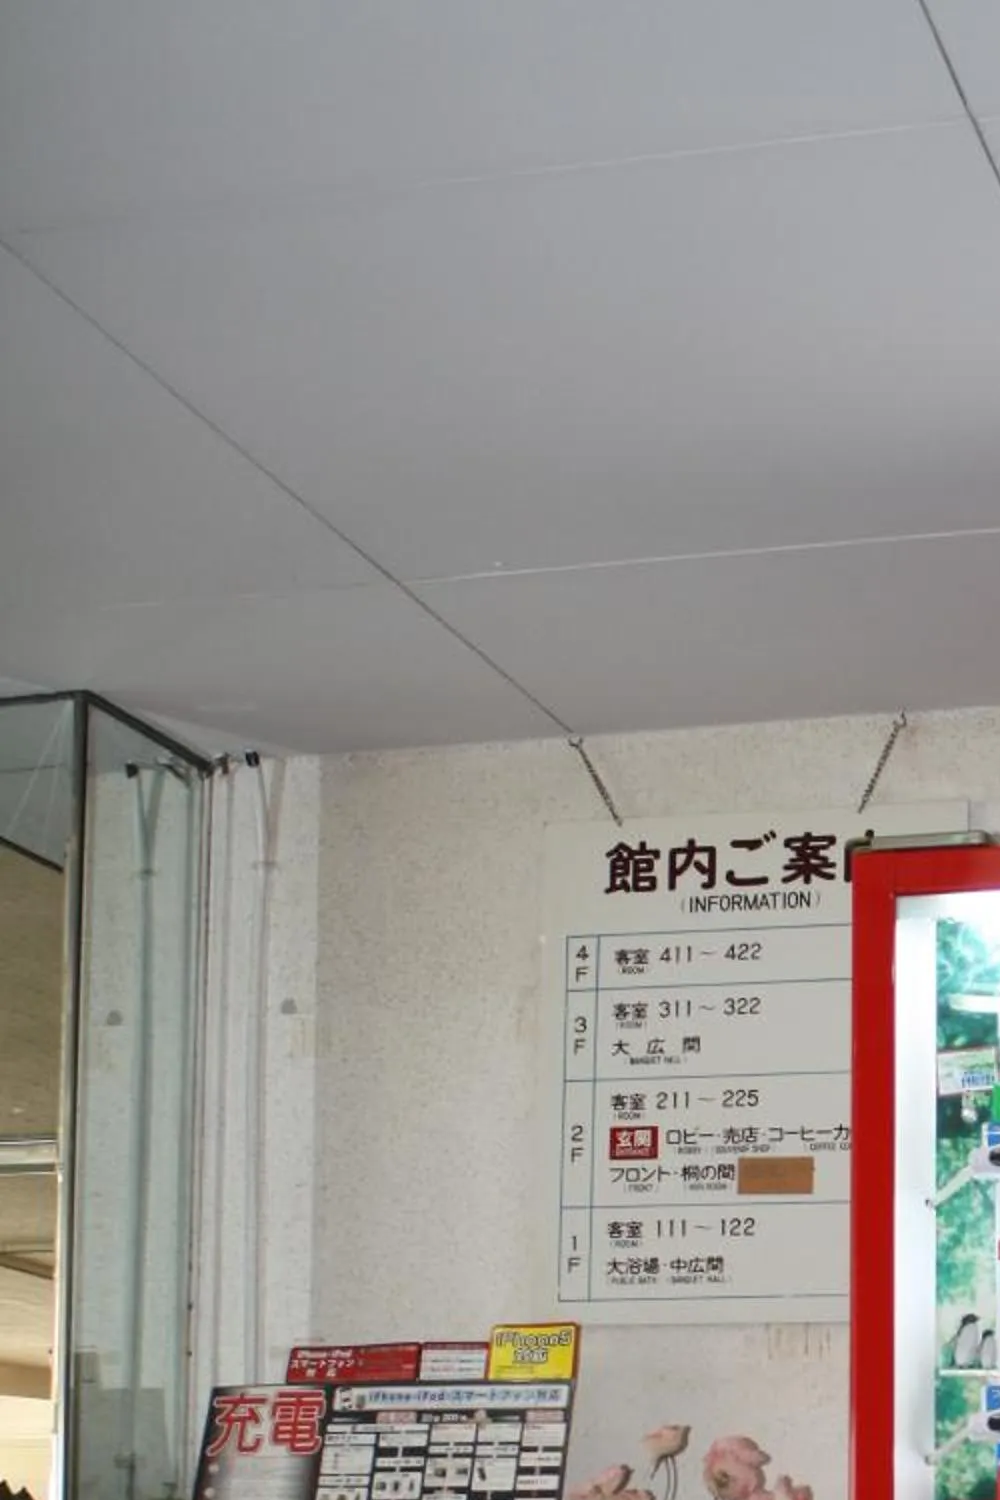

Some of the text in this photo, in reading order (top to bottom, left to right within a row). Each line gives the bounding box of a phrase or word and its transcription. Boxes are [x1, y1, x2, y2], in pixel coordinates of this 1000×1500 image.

[604, 830, 853, 894] 館内ご案
[614, 949, 650, 966] 客室
[659, 945, 693, 964] 411
[723, 943, 764, 962] 422
[613, 1002, 649, 1020] 客室
[658, 1000, 692, 1019] 311
[722, 997, 762, 1016] 322
[610, 1094, 647, 1111] 客室
[655, 1091, 690, 1110] 211
[721, 1089, 760, 1108] 225
[607, 1221, 644, 1240] 客室
[655, 1218, 688, 1239] 111
[720, 1217, 756, 1237] 122
[205, 1389, 327, 1457] 充電
